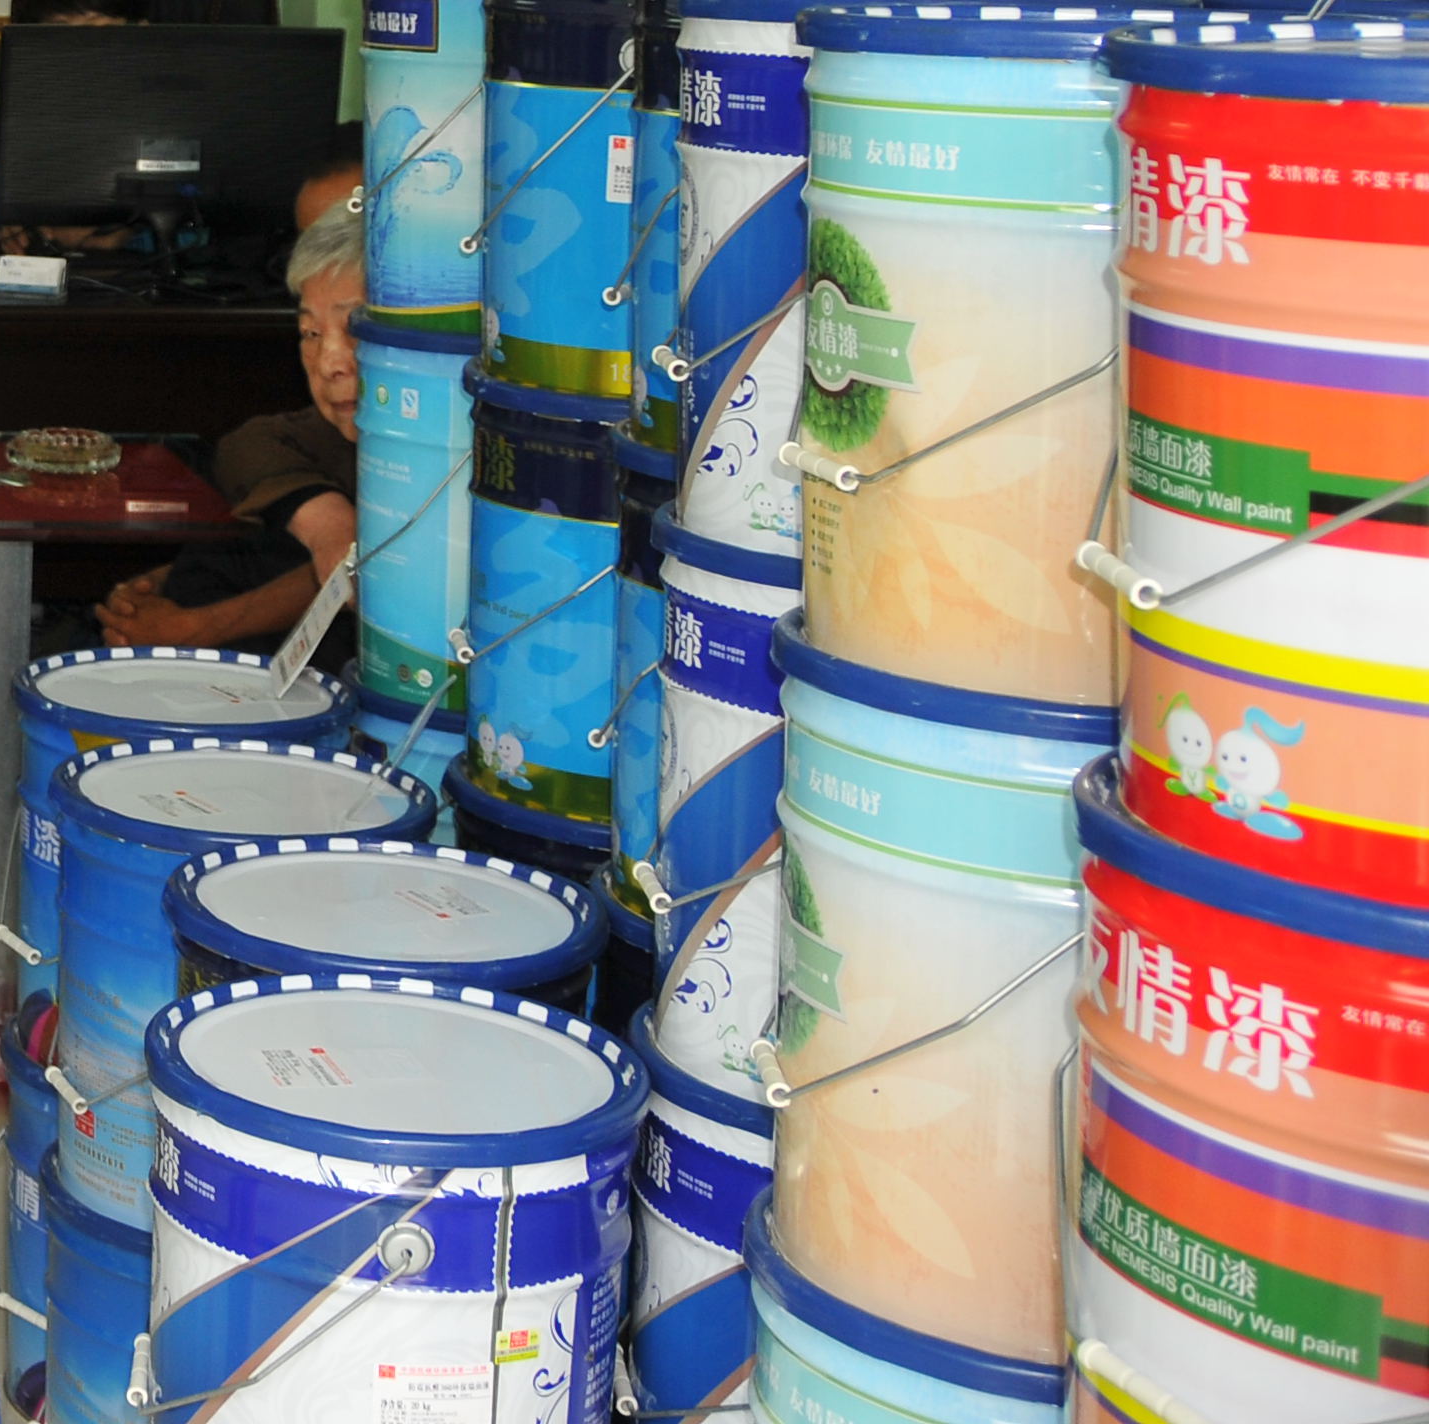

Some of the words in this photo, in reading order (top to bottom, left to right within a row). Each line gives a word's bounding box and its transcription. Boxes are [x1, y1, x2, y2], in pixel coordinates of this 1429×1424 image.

[866, 138, 961, 172] 友情最好
[1268, 163, 1340, 186] 友情常在
[805, 315, 859, 361] 友情漆
[1160, 476, 1203, 508] Quality
[1206, 489, 1242, 514] Wall
[1245, 500, 1293, 525] paint
[807, 765, 882, 818] 友情最好
[1342, 1003, 1426, 1037] 友情常在
[1112, 1237, 1178, 1293] NEMESIS
[1180, 1280, 1245, 1327] Quality
[1249, 1311, 1296, 1344] Wall
[1301, 1335, 1359, 1365] paint
